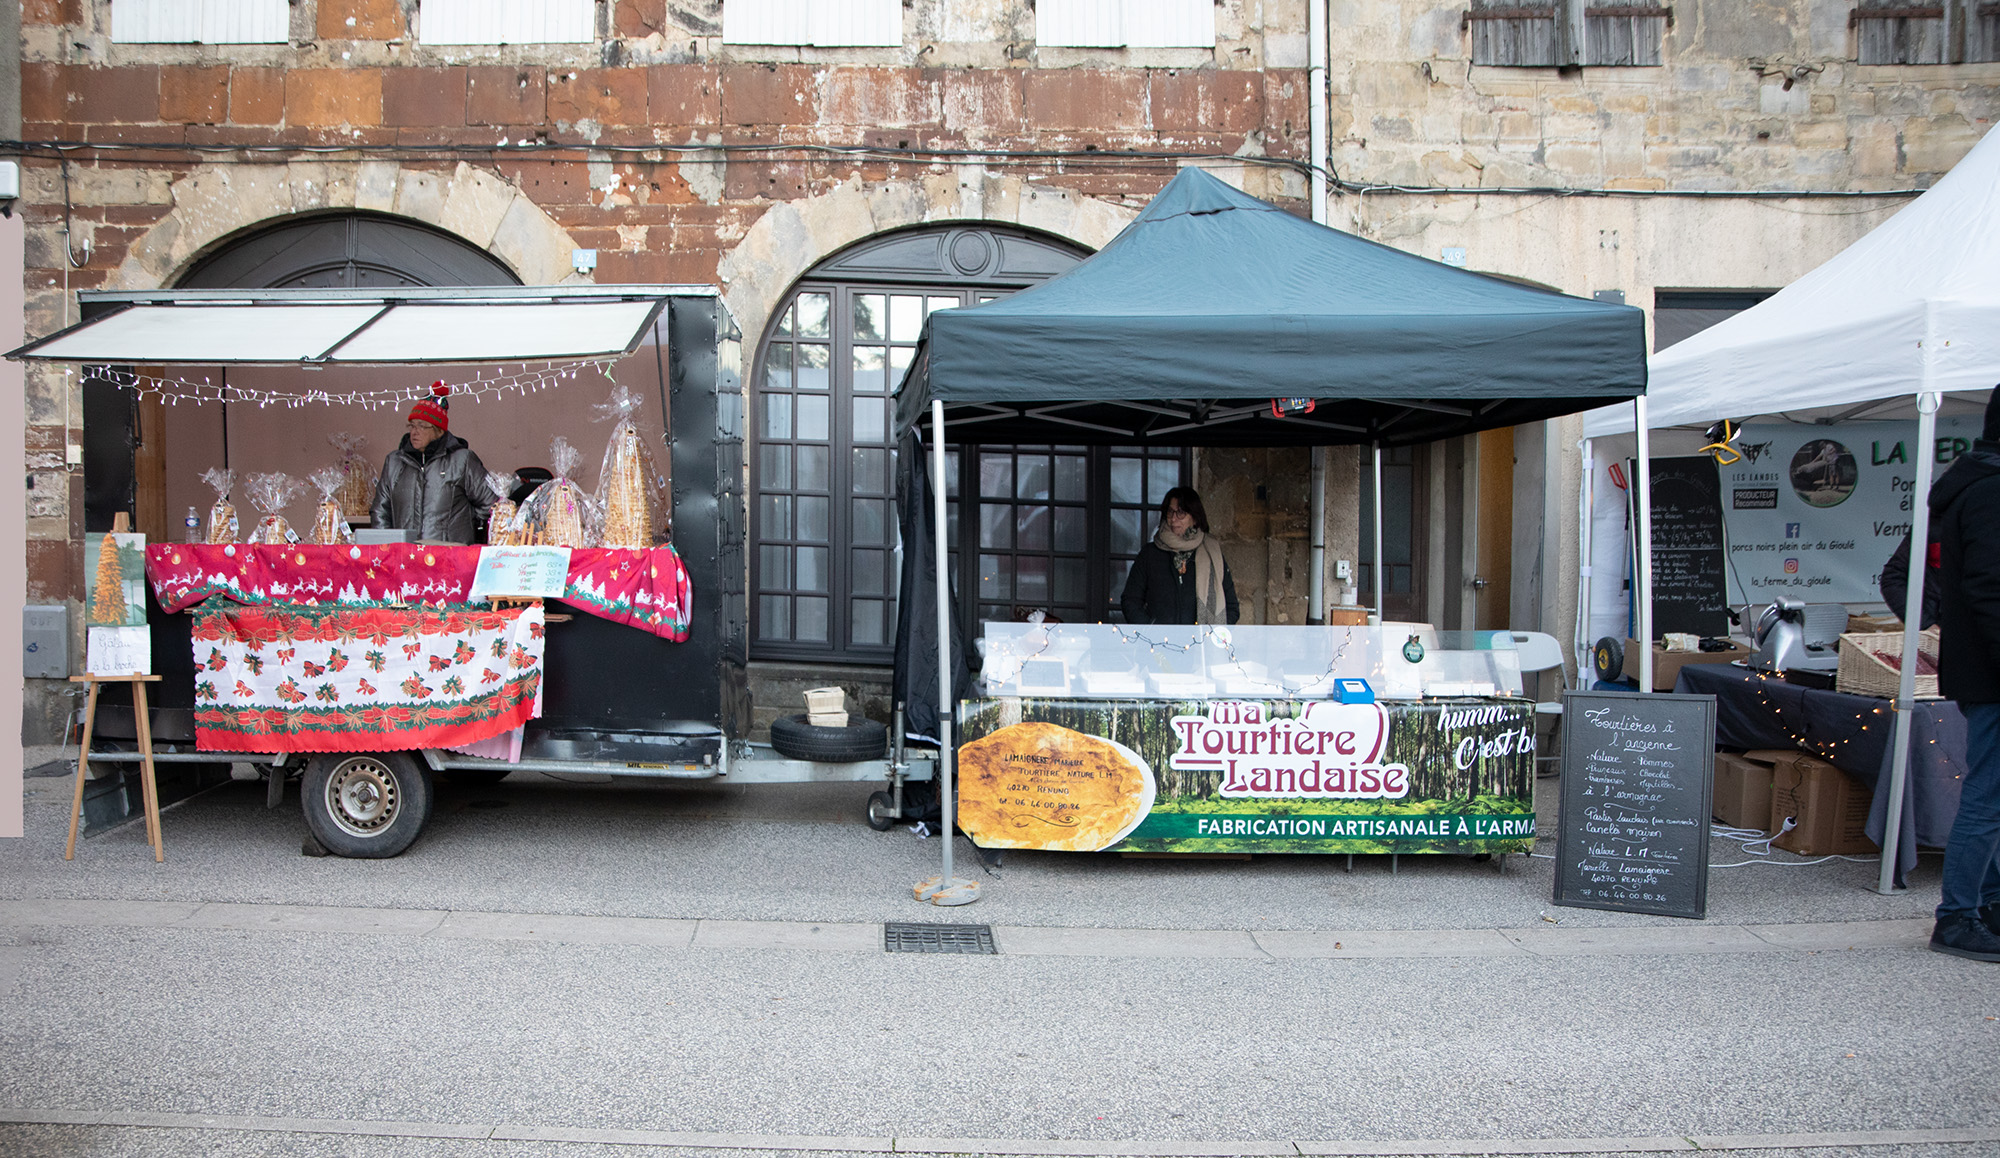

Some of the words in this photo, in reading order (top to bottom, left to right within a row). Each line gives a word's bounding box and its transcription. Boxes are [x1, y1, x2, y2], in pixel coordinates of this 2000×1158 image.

[1447, 251, 1462, 262] 49
[1871, 440, 1908, 467] LA
[1732, 474, 1746, 482] LES
[1749, 472, 1779, 481] LANDES
[1734, 490, 1776, 499] PRODUCTEUR
[1731, 543, 1753, 554] porcs
[1756, 542, 1776, 551] noirs
[1778, 541, 1798, 553] plein
[1801, 542, 1813, 550] air
[1815, 541, 1826, 550] du
[1828, 539, 1855, 550] Gioulé
[1751, 577, 1832, 588] la_ferme_du_gioule
[1212, 702, 1261, 724] ma
[1437, 704, 1521, 731] humm...
[1584, 707, 1657, 733] Tourtières
[1662, 719, 1676, 733] à
[1175, 721, 1356, 755] Tourtière
[1455, 728, 1520, 770] C'est
[1637, 755, 1675, 768] Pommes
[1067, 771, 1095, 779] NATURE
[1223, 759, 1405, 793] Landaise
[1639, 768, 1671, 779] Chocolat
[1006, 784, 1030, 792] 40270
[1582, 785, 1595, 796] à
[1198, 819, 1325, 836] FABRICATION
[1331, 819, 1450, 836] ARTISANALE
[1455, 816, 1470, 836] À
[1577, 858, 1612, 876] Marielle
[1591, 873, 1616, 883] 40270
